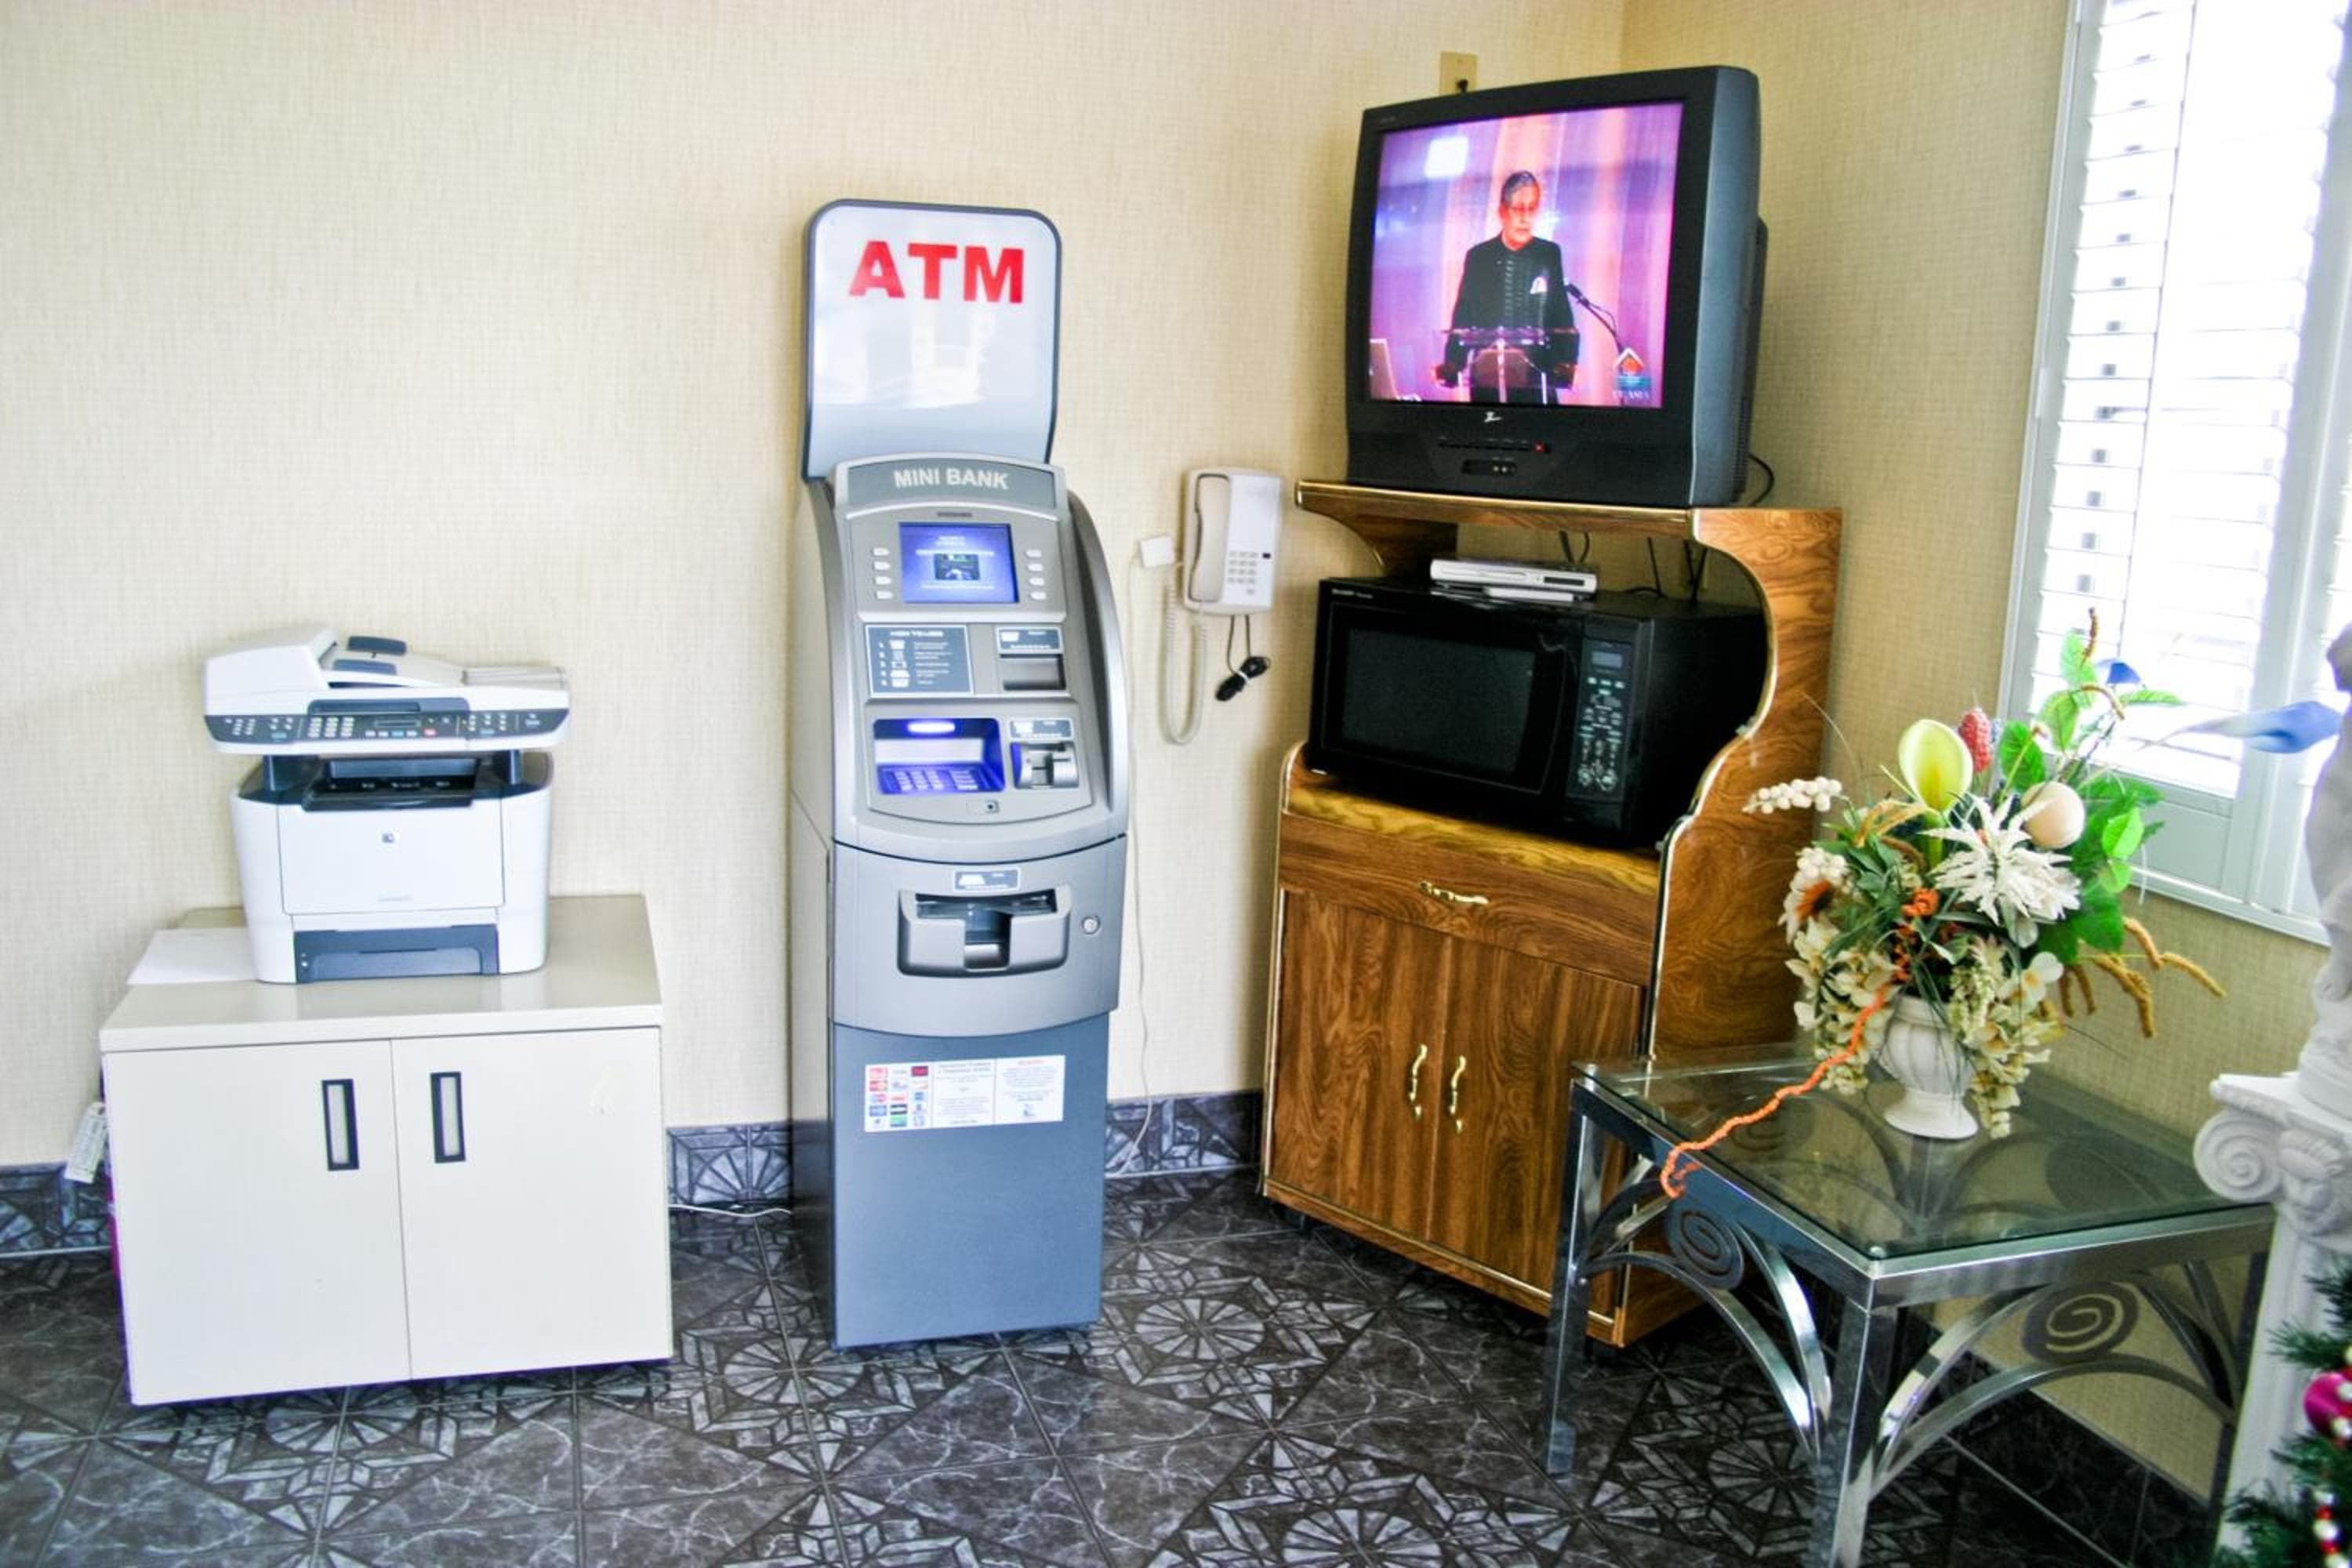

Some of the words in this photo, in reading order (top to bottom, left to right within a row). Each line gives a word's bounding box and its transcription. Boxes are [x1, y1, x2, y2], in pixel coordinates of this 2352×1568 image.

[849, 240, 1024, 304] ATM
[894, 468, 941, 488] MINI
[946, 467, 1010, 490] BANK
